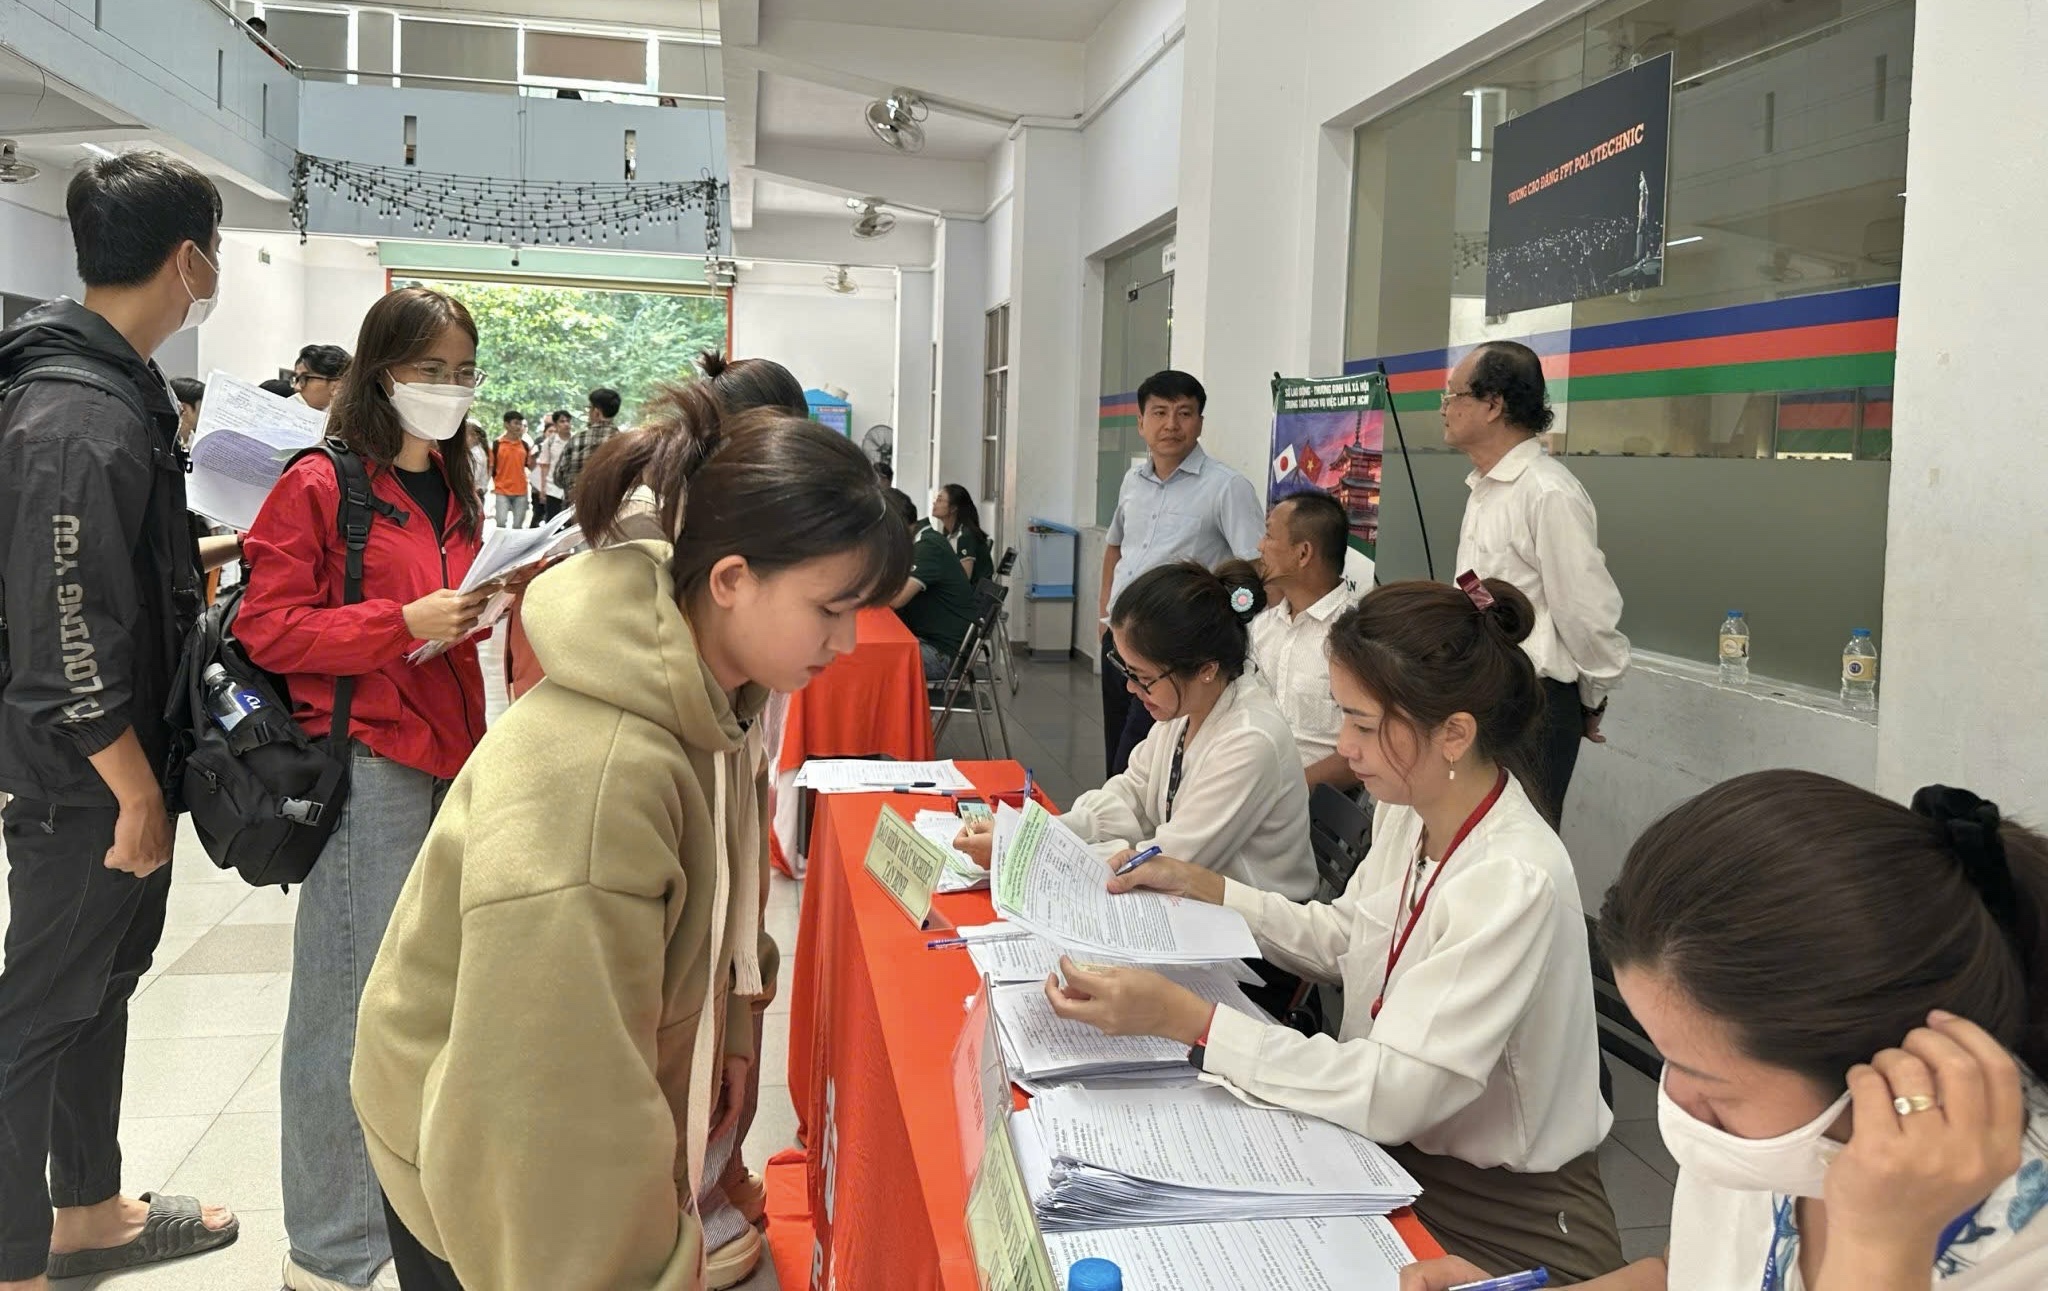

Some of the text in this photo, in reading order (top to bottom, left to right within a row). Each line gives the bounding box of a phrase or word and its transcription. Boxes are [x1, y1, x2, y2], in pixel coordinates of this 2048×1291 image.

[1560, 159, 1573, 181] FPT
[1574, 122, 1645, 174] POLYTECHNIC
[52, 514, 80, 576] YOU
[57, 583, 104, 694] LOVING
